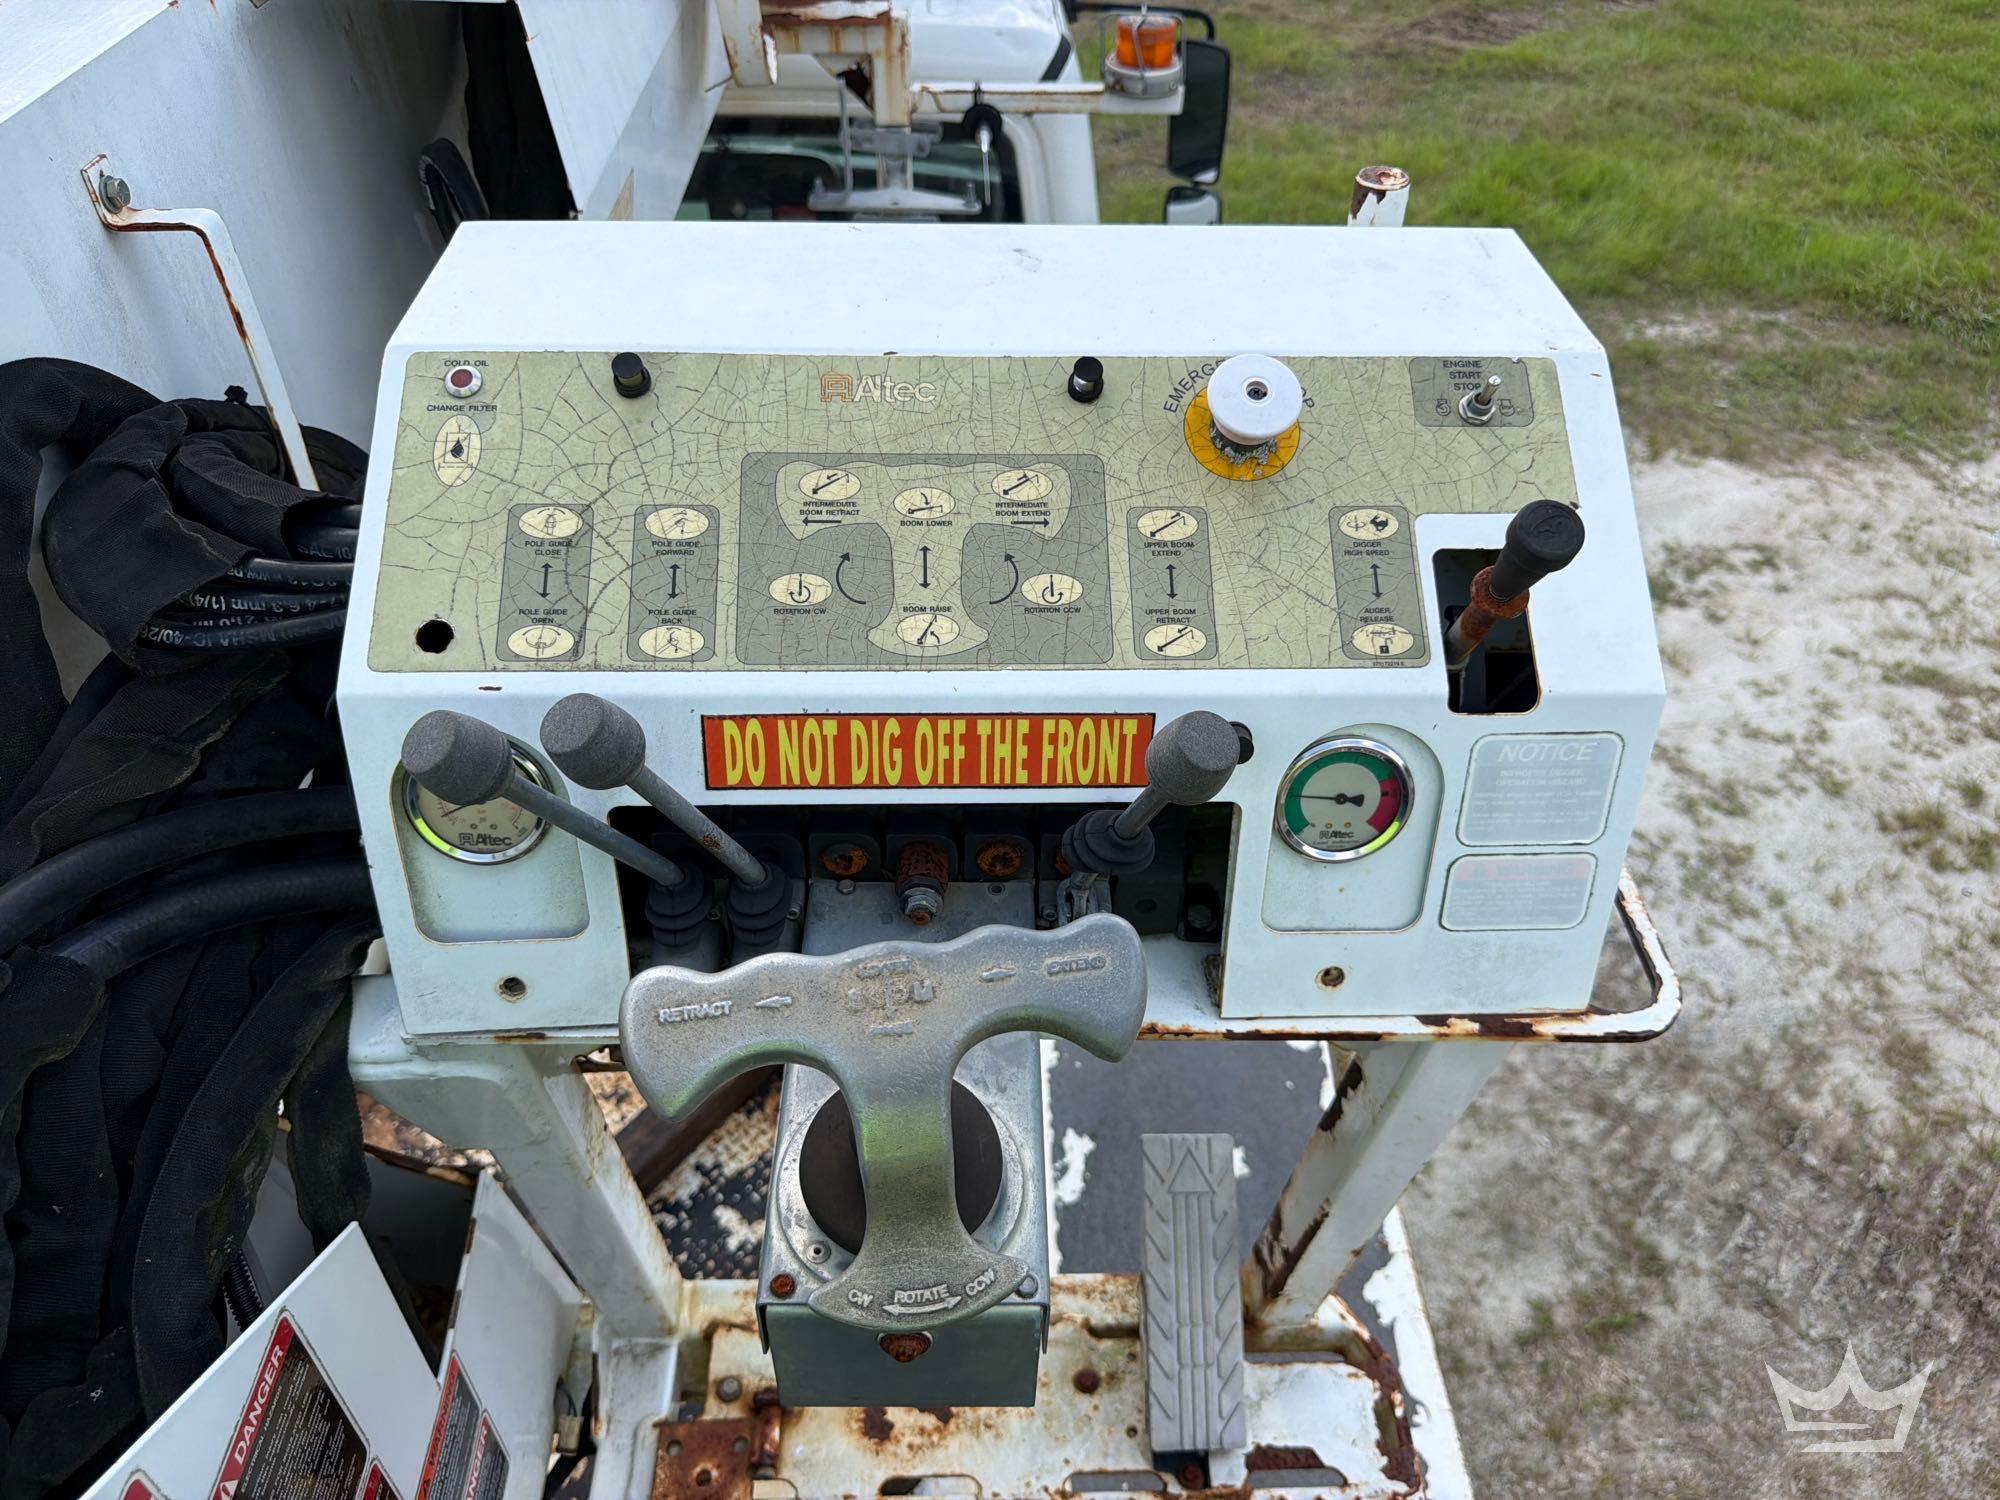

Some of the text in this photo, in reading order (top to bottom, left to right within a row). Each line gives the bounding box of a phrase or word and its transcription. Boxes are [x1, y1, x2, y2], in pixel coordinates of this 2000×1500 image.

[444, 360, 489, 368] COLD OIL
[1443, 360, 1482, 368] ENGINE
[1449, 371, 1481, 379] START
[853, 374, 938, 403] Altec
[1163, 359, 1226, 414] EMERG
[1454, 382, 1482, 391] STOP
[426, 404, 498, 413] CHANGE FILTER
[524, 540, 574, 548] POLE GUIDE
[651, 540, 700, 548] POLE GUIDE
[519, 608, 568, 616] POLE GUIDE
[648, 608, 697, 616] POLE GUIDE
[1359, 615, 1394, 623] RELEASE
[723, 717, 1138, 786] DO NOT DIG OFF THE FRONT
[1498, 742, 1597, 763] NOTICE
[475, 833, 513, 847] Altec
[1329, 830, 1355, 839] Altec
[1047, 956, 1106, 975] EXTEND
[658, 999, 733, 1025] RETRACT
[965, 1267, 996, 1297] CCW
[847, 1288, 874, 1308] CW
[893, 1283, 950, 1305] ROTATE
[234, 1344, 284, 1466] DANGER
[429, 1371, 456, 1466] WARNING
[240, 1385, 283, 1494] ELECTRICAL HAZARDS
